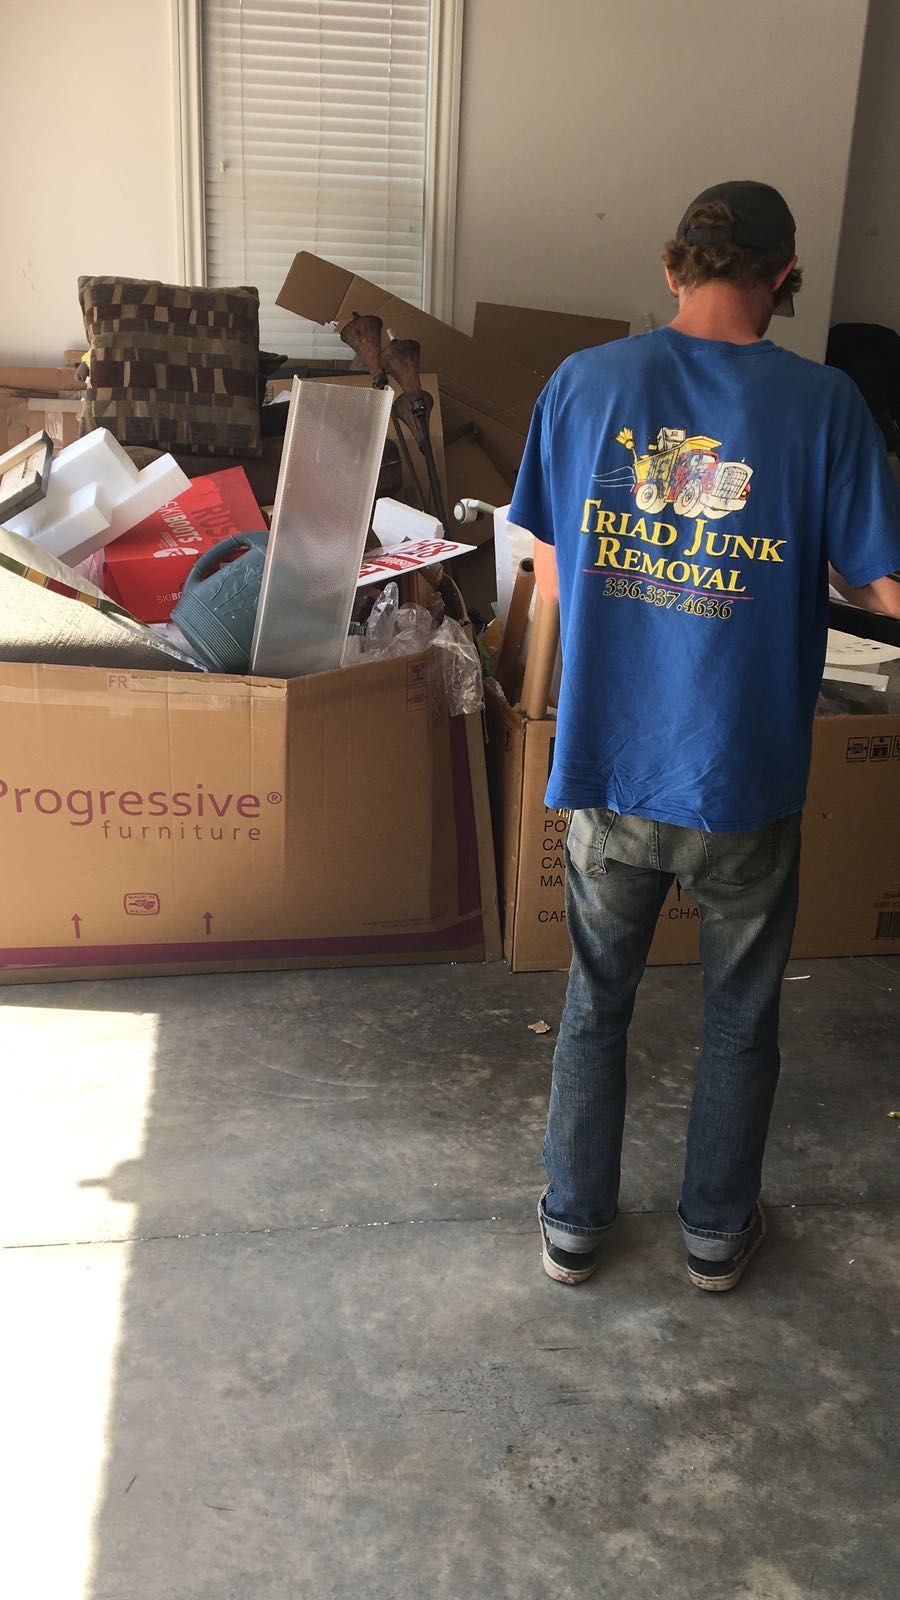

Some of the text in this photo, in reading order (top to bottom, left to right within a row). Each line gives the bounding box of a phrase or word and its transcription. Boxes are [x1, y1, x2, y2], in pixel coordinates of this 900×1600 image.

[580, 498, 787, 563] TRIAD JUNK
[594, 536, 747, 593] REMOVAL
[603, 577, 734, 620] 336.337.4636
[101, 820, 261, 841] furniture
[541, 856, 566, 869] CA
